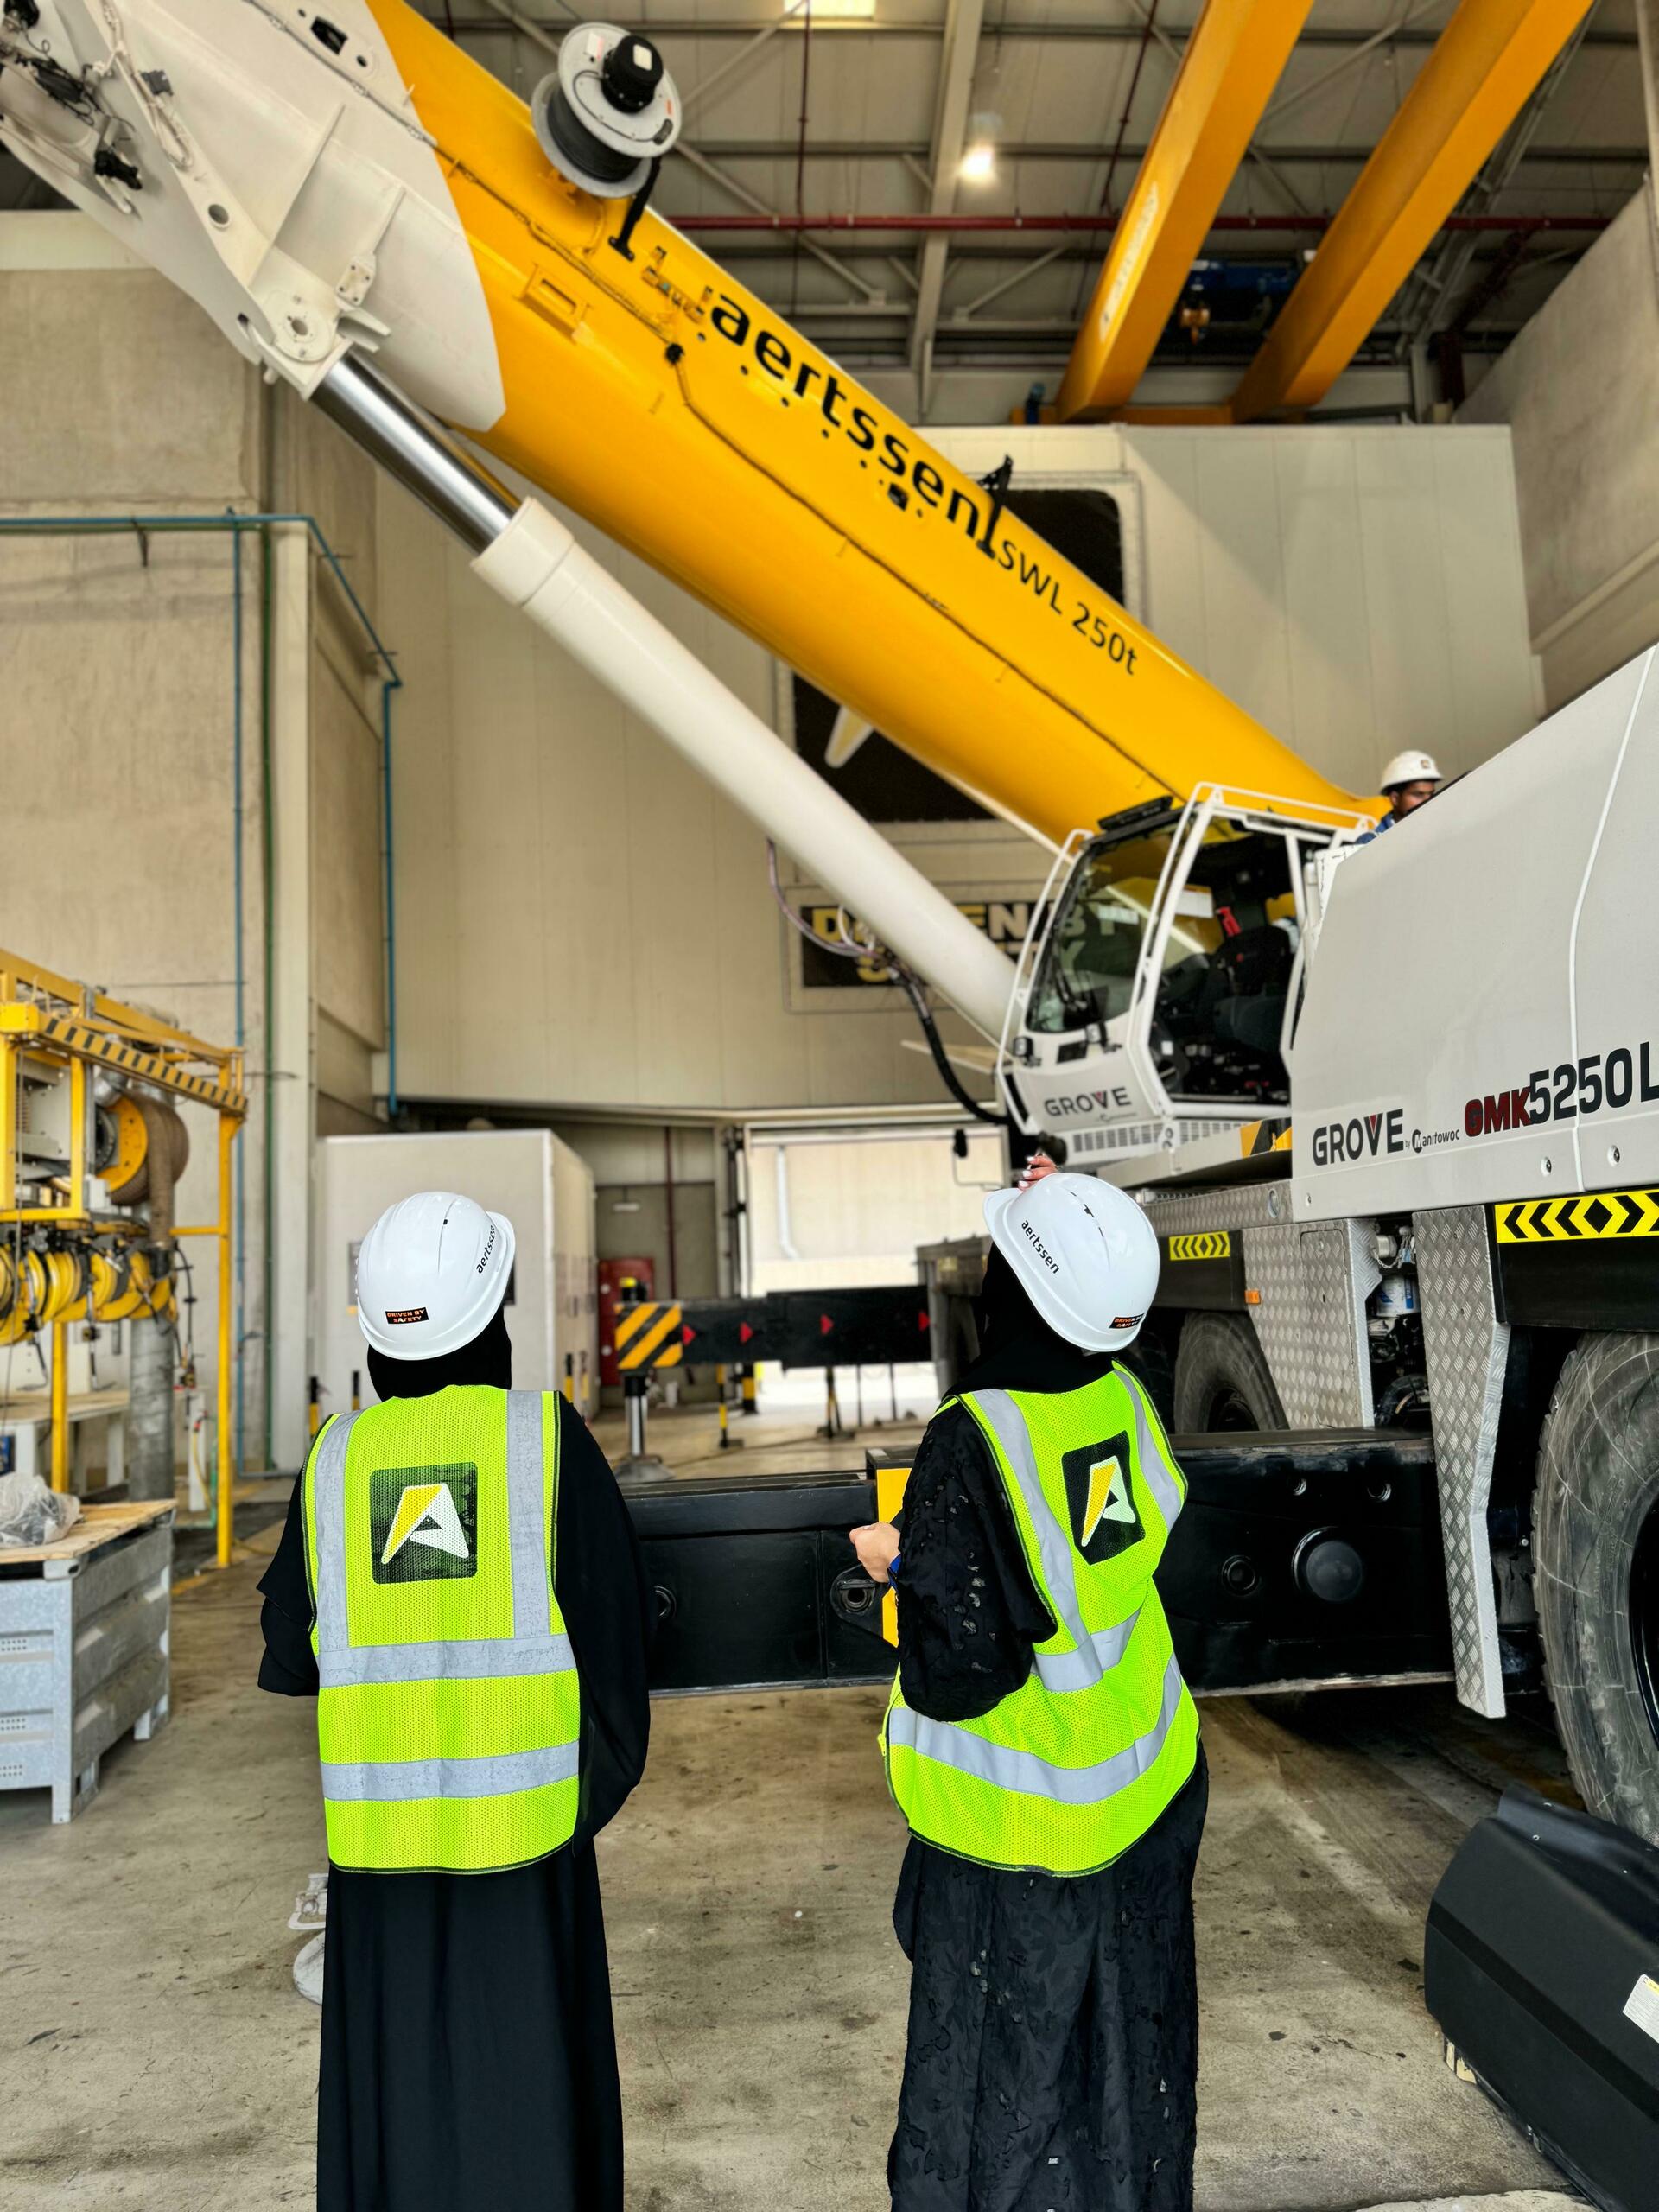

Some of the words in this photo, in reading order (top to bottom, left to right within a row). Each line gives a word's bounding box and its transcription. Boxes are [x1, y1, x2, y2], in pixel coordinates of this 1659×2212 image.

[711, 293, 980, 540] aertssen
[998, 539, 1063, 616] SWL
[1072, 601, 1138, 676] 250t
[1044, 1086, 1132, 1116] GROVE
[1313, 1108, 1404, 1166] GROVE
[476, 1224, 495, 1274] aertssen
[1021, 1219, 1059, 1274] aertssen
